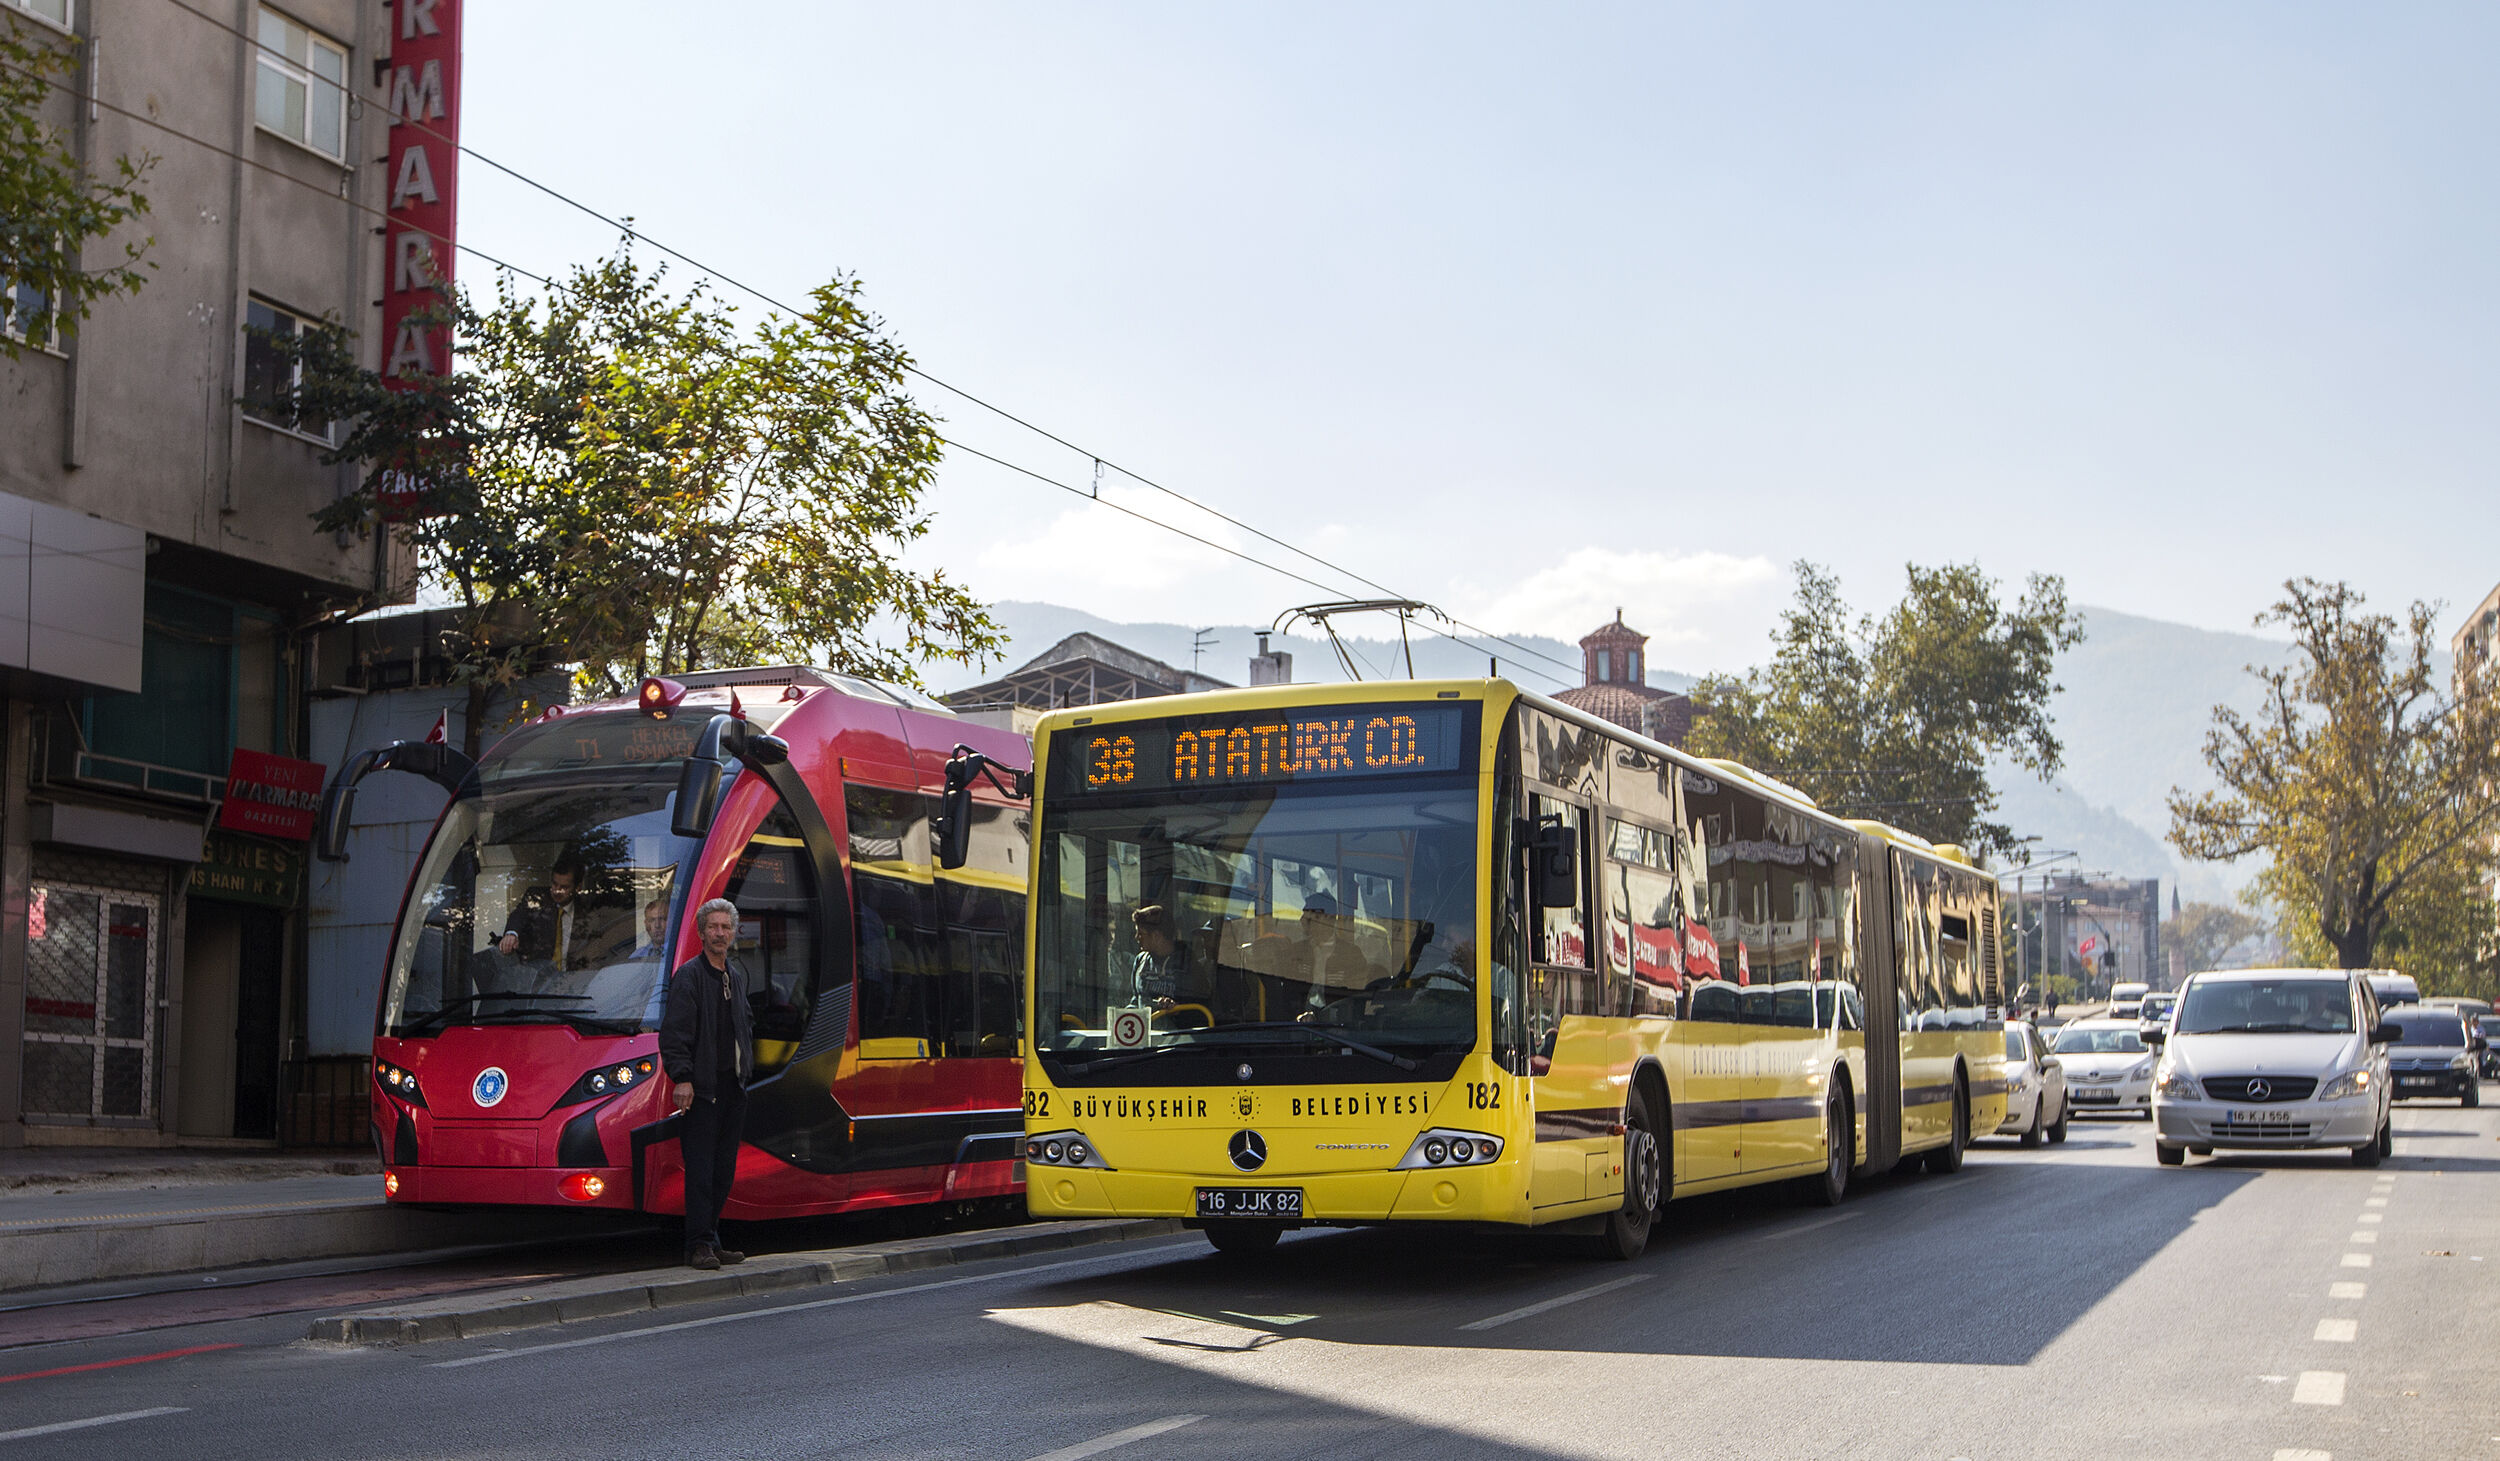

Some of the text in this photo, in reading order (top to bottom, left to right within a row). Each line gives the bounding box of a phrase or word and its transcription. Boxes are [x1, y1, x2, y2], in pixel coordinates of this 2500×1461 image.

[632, 726, 693, 744] HEYKEL
[576, 738, 602, 759] T1
[1088, 736, 1135, 786] 38
[231, 779, 322, 811] MARMARA
[1123, 1020, 1136, 1039] 3
[1073, 1091, 1428, 1121] BÜYÜKŞEHİR BELEDİYESİ
[1466, 1082, 1500, 1110] 182
[1208, 1192, 1299, 1210] 16 JJK 82
